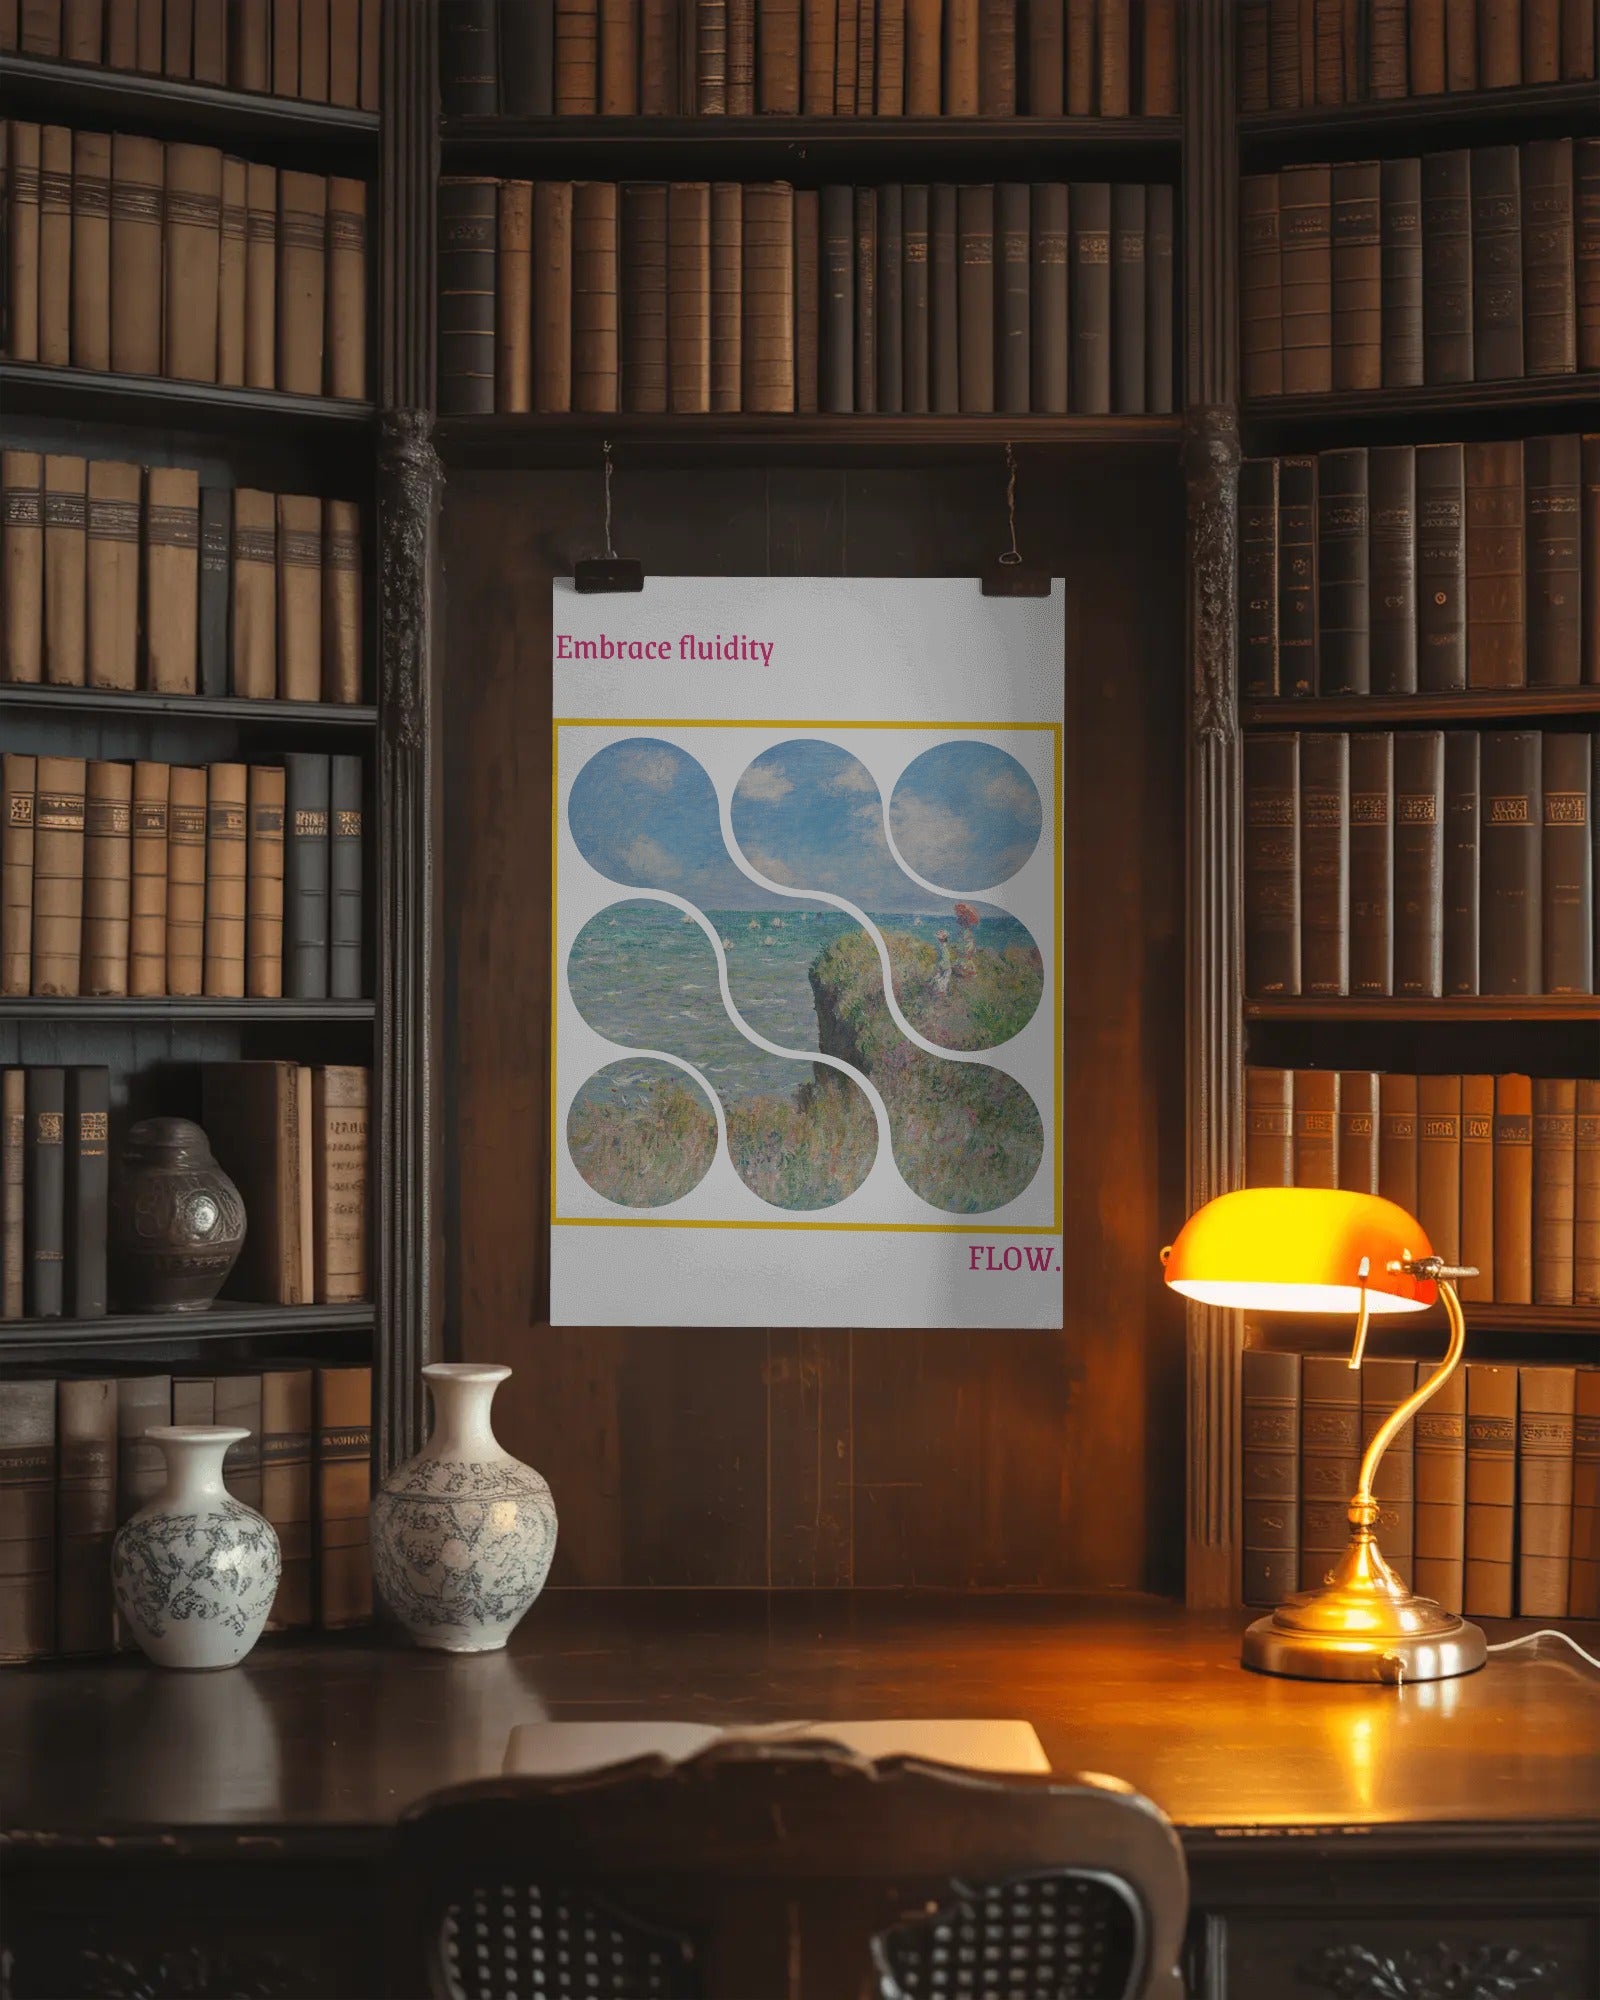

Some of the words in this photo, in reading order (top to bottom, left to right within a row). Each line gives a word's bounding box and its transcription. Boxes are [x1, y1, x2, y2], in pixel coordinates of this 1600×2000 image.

[557, 634, 672, 660] Embrace
[679, 634, 774, 667] fluidity
[969, 1246, 1060, 1271] FLOW.
